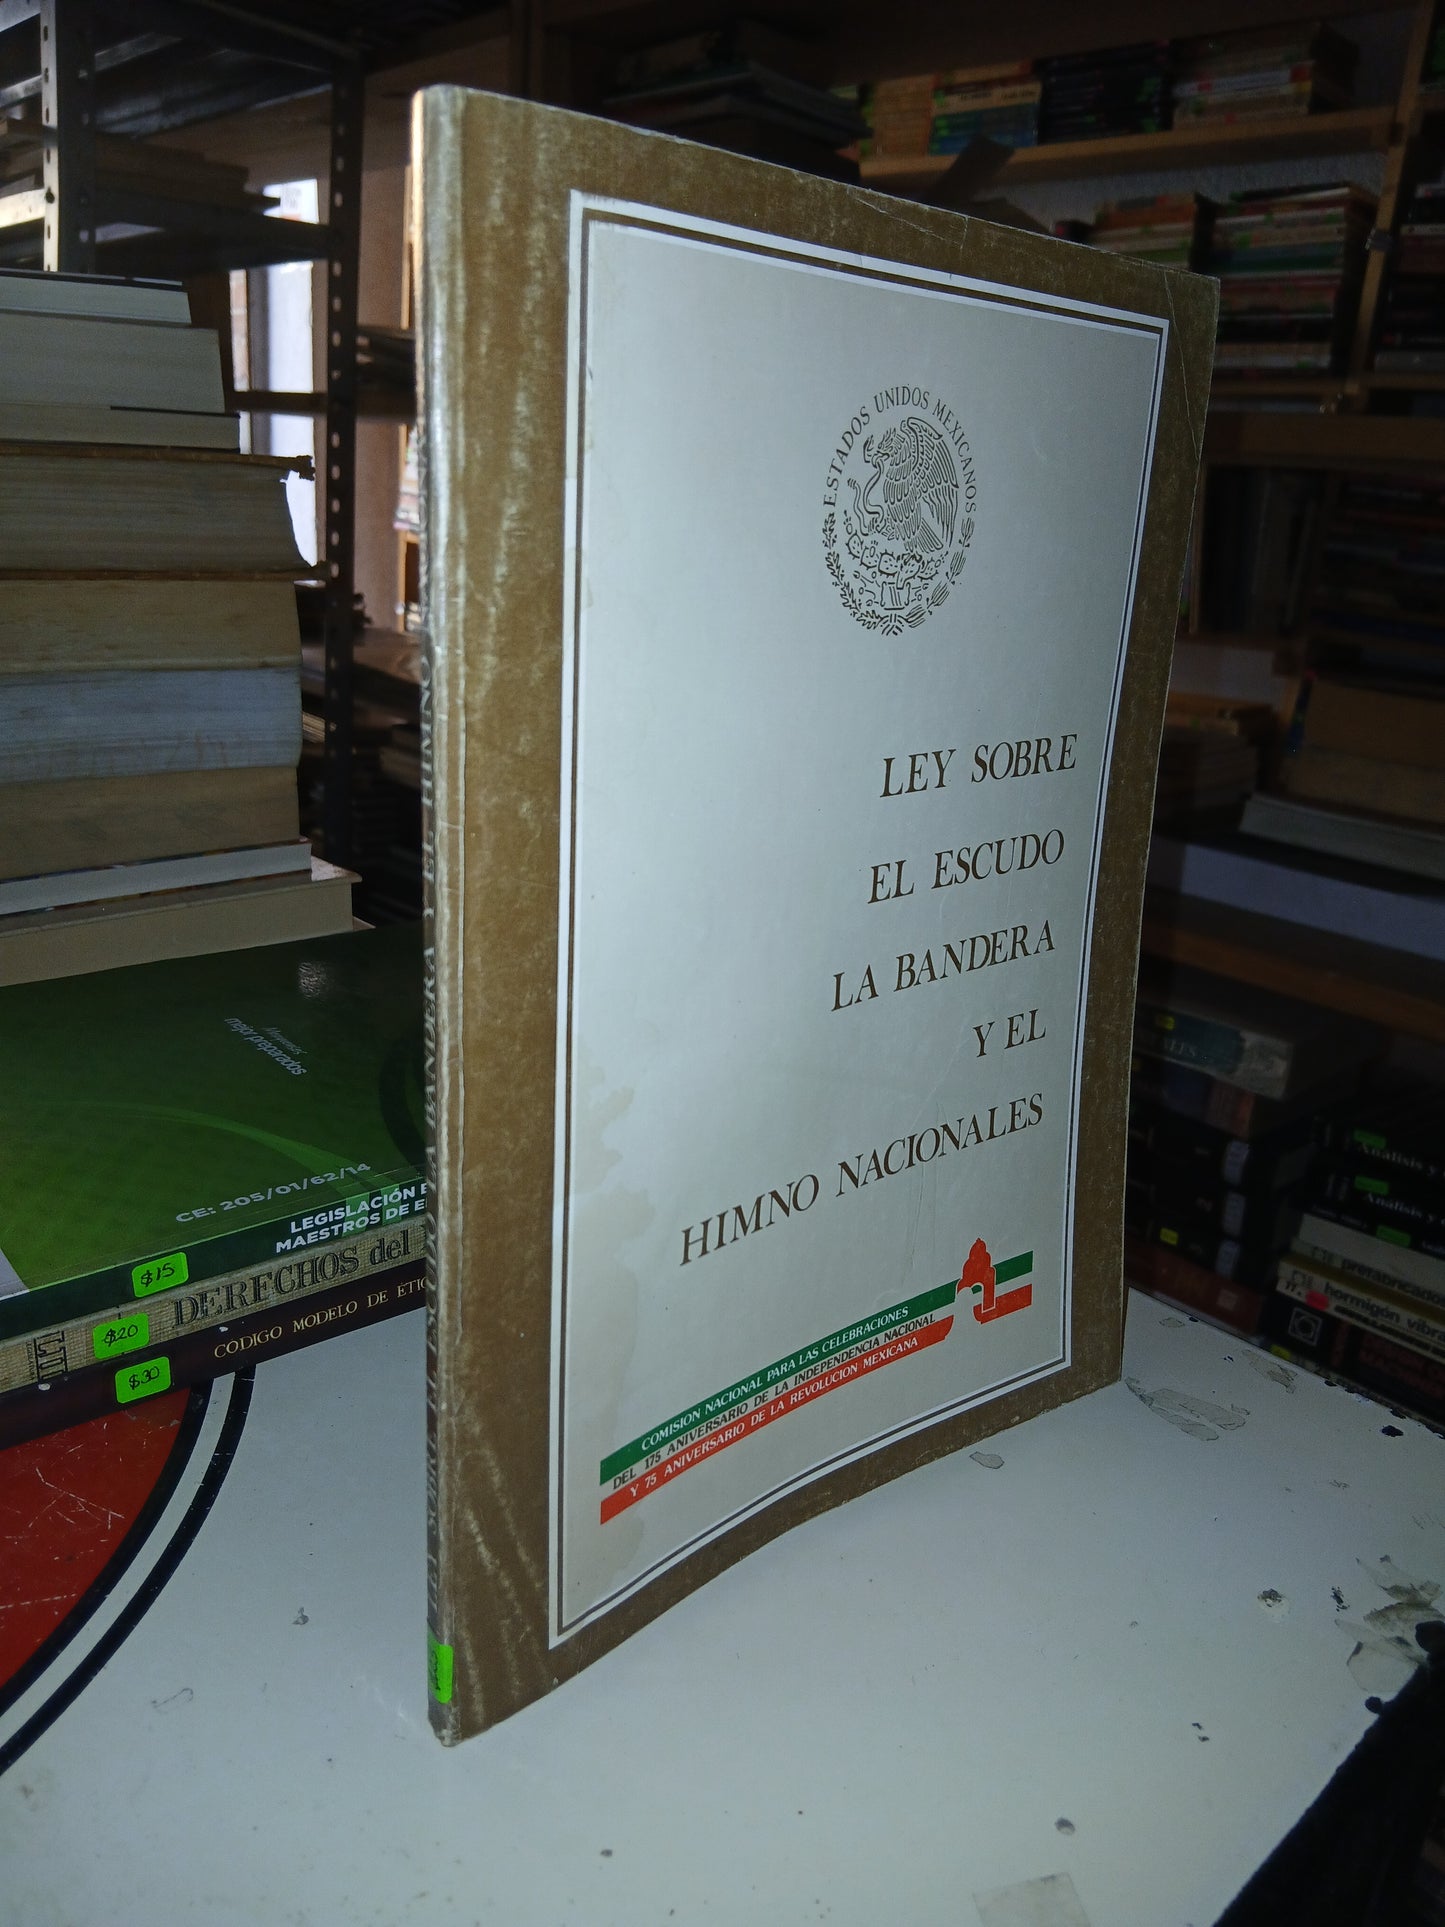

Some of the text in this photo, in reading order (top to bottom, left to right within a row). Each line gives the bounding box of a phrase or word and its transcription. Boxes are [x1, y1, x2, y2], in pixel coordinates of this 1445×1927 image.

[823, 385, 977, 513] ESTADOS UNIDOS MEXICANOS
[420, 655, 433, 808] HIMNO
[879, 733, 1078, 798] LEY SOBRE
[421, 830, 435, 884] EL
[867, 829, 1065, 904] EL ESCUDO
[421, 896, 435, 919] Y
[830, 919, 1056, 1012] LA BANDERA
[243, 1035, 307, 1075] preparados
[423, 946, 436, 1130] BANDERA
[972, 1008, 1047, 1058] Y EL
[175, 1162, 371, 1223] CE: 205/01/62/14
[424, 1145, 436, 1193] LA
[679, 1092, 1044, 1267] HIMNO NACIONALES
[276, 1212, 381, 1254] MAESTROS
[385, 1203, 409, 1220] DE
[290, 1186, 415, 1234] LEGISLACIÓN
[140, 1262, 175, 1288] $15
[173, 1229, 412, 1328] DERECHOS del
[103, 1324, 139, 1348] $20
[292, 1301, 358, 1333] MODELO
[366, 1290, 389, 1308] DE
[128, 1365, 160, 1391] $30
[612, 1313, 936, 1490] DEL 175 ANIVERSARIO DE LA INDEPENDENCIA NACIONAL
[641, 1305, 909, 1451] COMISION NACIONAL PARA LAS CELEBRACIONES
[629, 1335, 918, 1498] Y 75 ANIVERSARIO DE LA REVOLUCION MEXICANA
